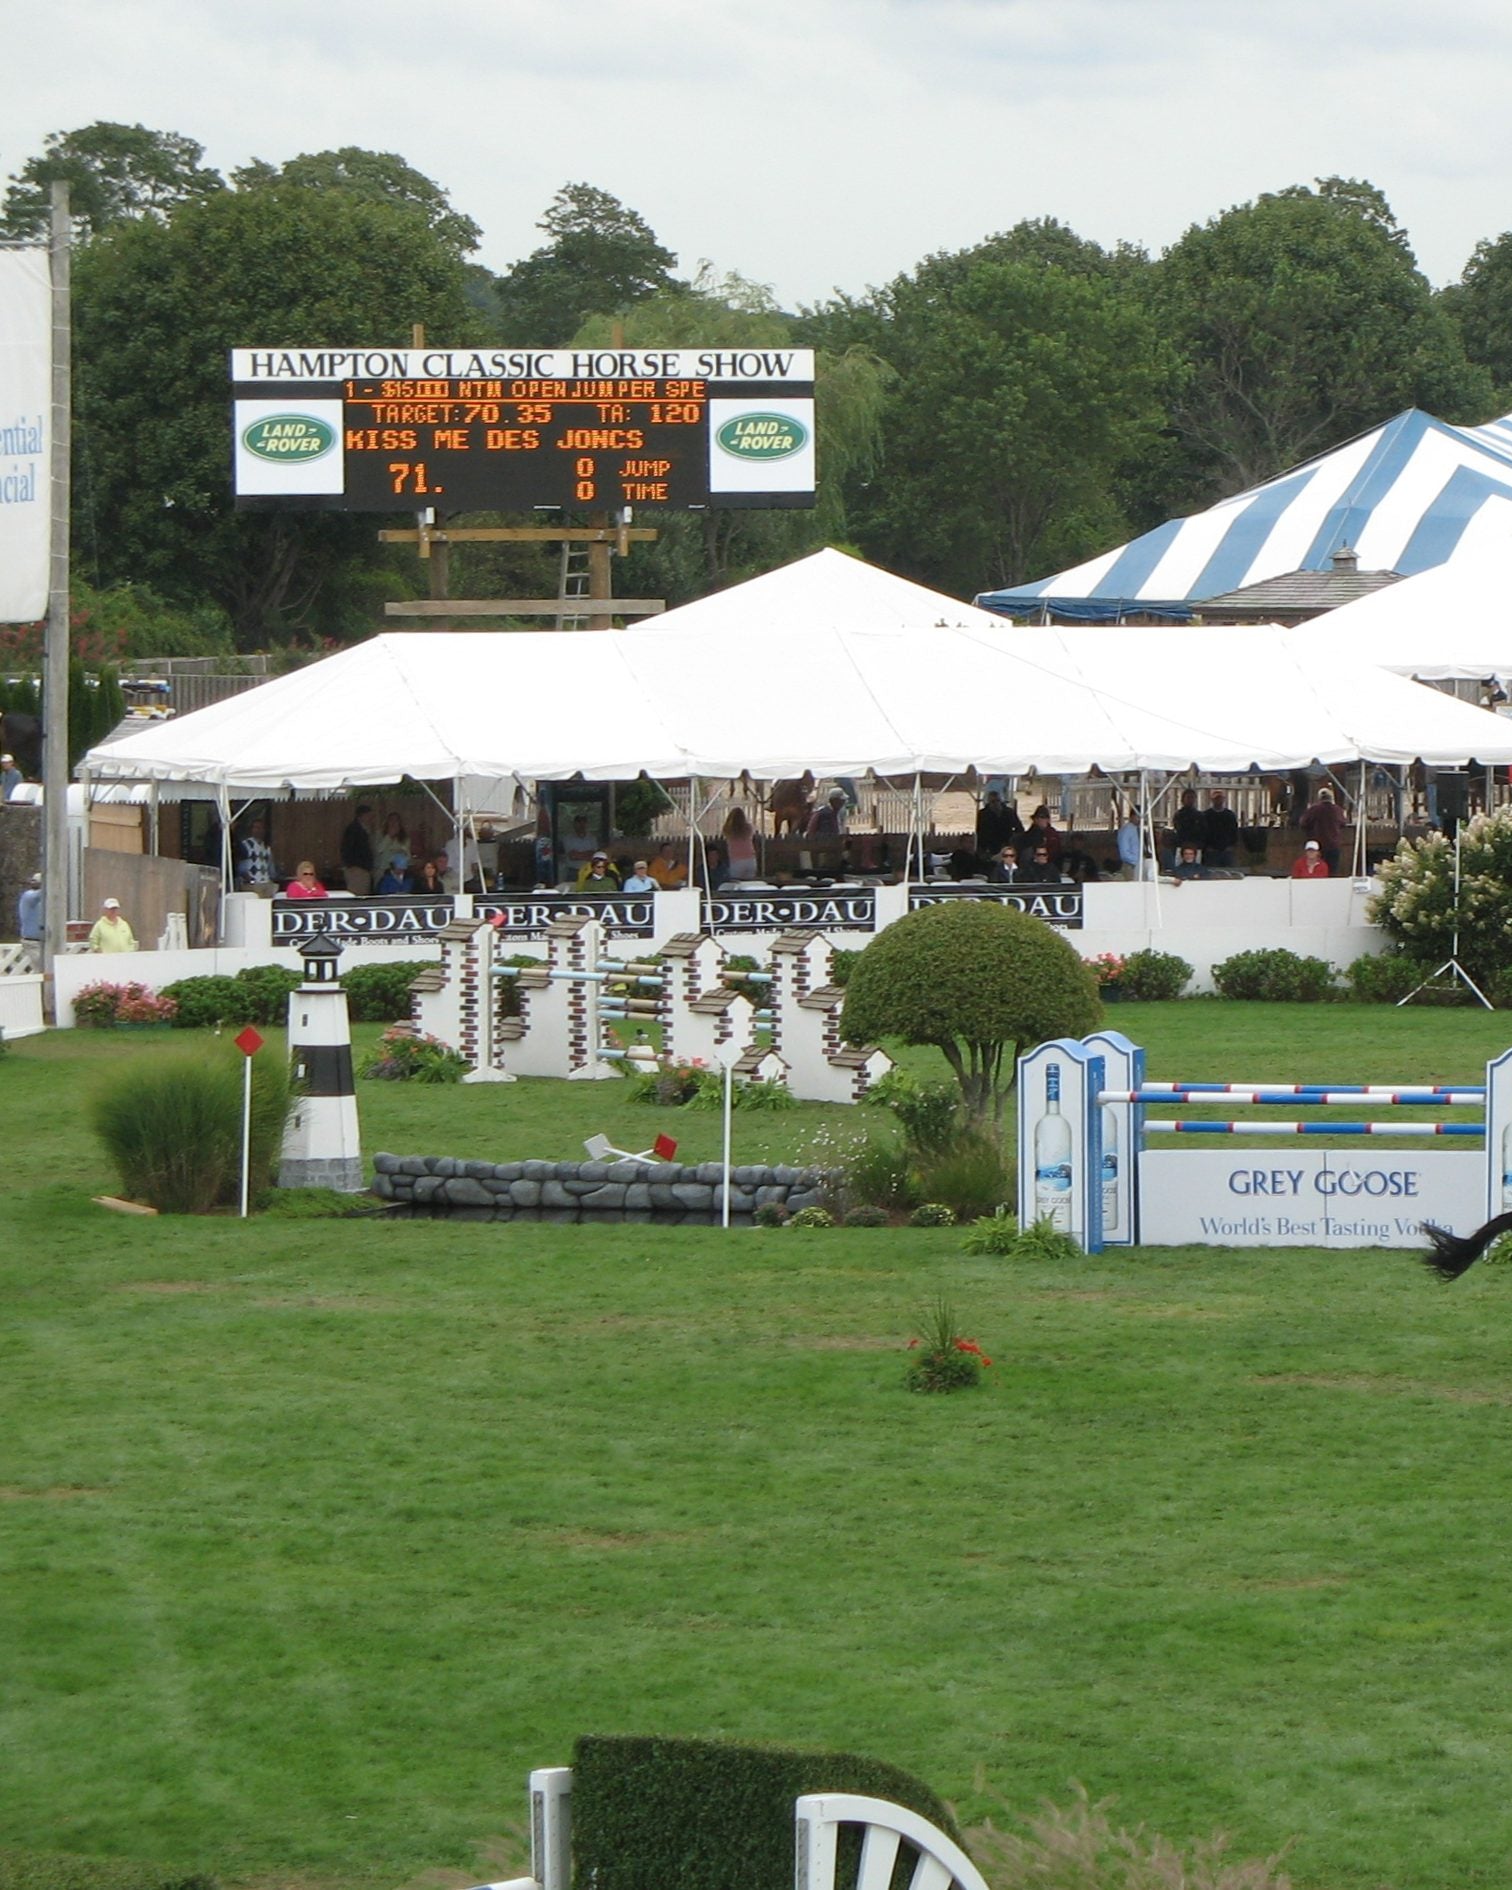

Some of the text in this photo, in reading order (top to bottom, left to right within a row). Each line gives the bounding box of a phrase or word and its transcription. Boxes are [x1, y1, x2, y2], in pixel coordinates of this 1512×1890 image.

[250, 353, 796, 378] HAMPTON CLASSIC HORSE SHOW
[511, 381, 566, 397] OPEN
[597, 404, 631, 423] TA:
[651, 404, 700, 423] 120
[261, 424, 306, 437] LAND
[734, 422, 779, 435] LAND
[265, 438, 321, 452] ROVER
[346, 430, 417, 450] KISS
[434, 430, 470, 449] ME
[487, 430, 540, 449] DES
[739, 436, 793, 449] ROVER
[576, 457, 671, 477] 0 JUMP
[576, 481, 669, 500] 0 TIME
[1228, 1169, 1419, 1197] GREY GOOSE
[1200, 1217, 1271, 1236] World's
[1277, 1217, 1316, 1236] Best
[1320, 1217, 1389, 1241] Tasting
